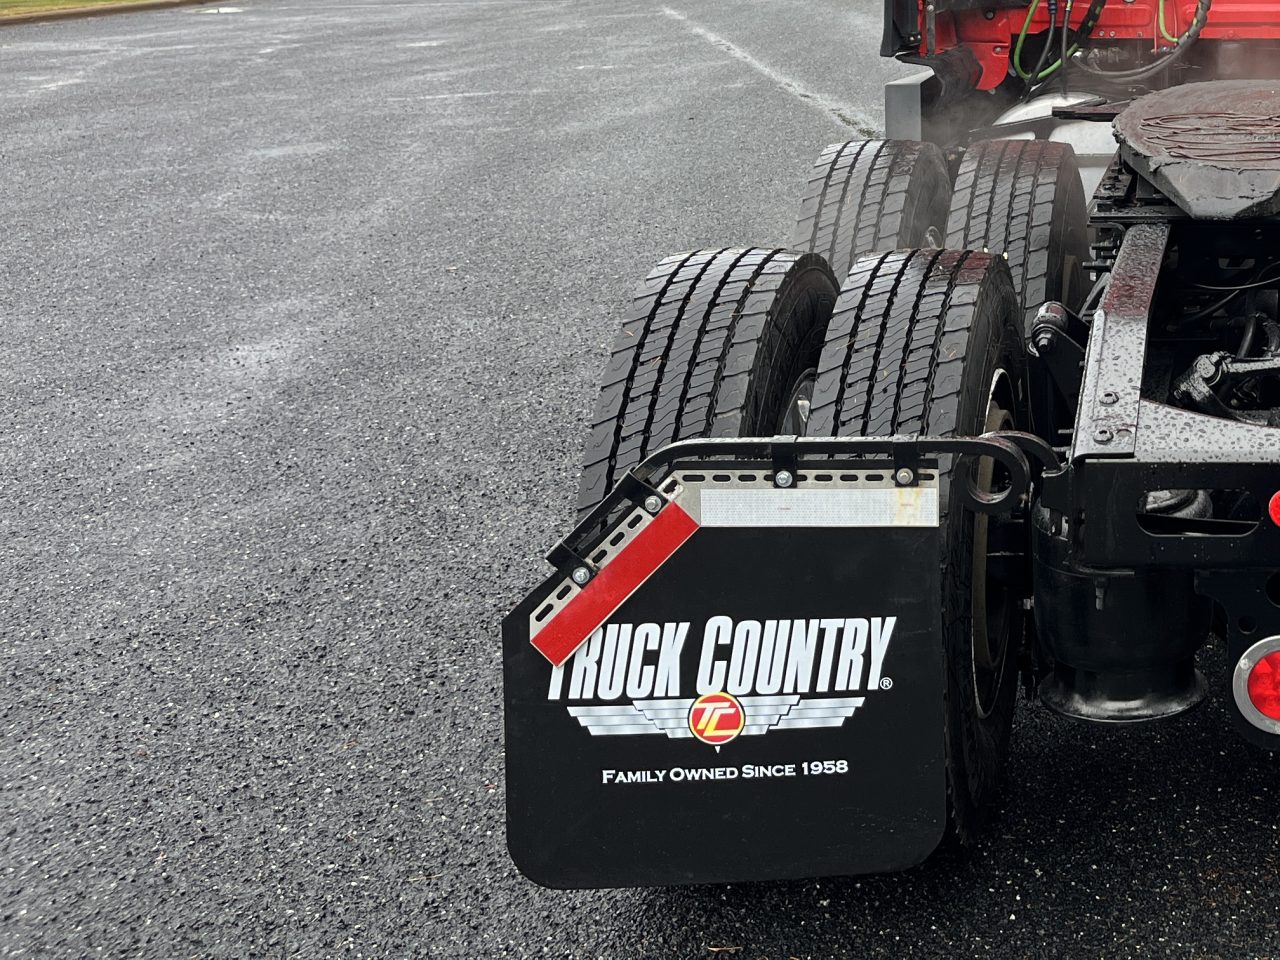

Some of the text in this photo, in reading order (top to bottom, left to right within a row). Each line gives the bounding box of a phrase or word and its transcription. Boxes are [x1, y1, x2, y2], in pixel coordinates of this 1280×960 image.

[696, 615, 897, 696] COUNTRY
[693, 701, 740, 737] TC
[602, 760, 849, 784] FAMILY OWNED SINCE 1958
